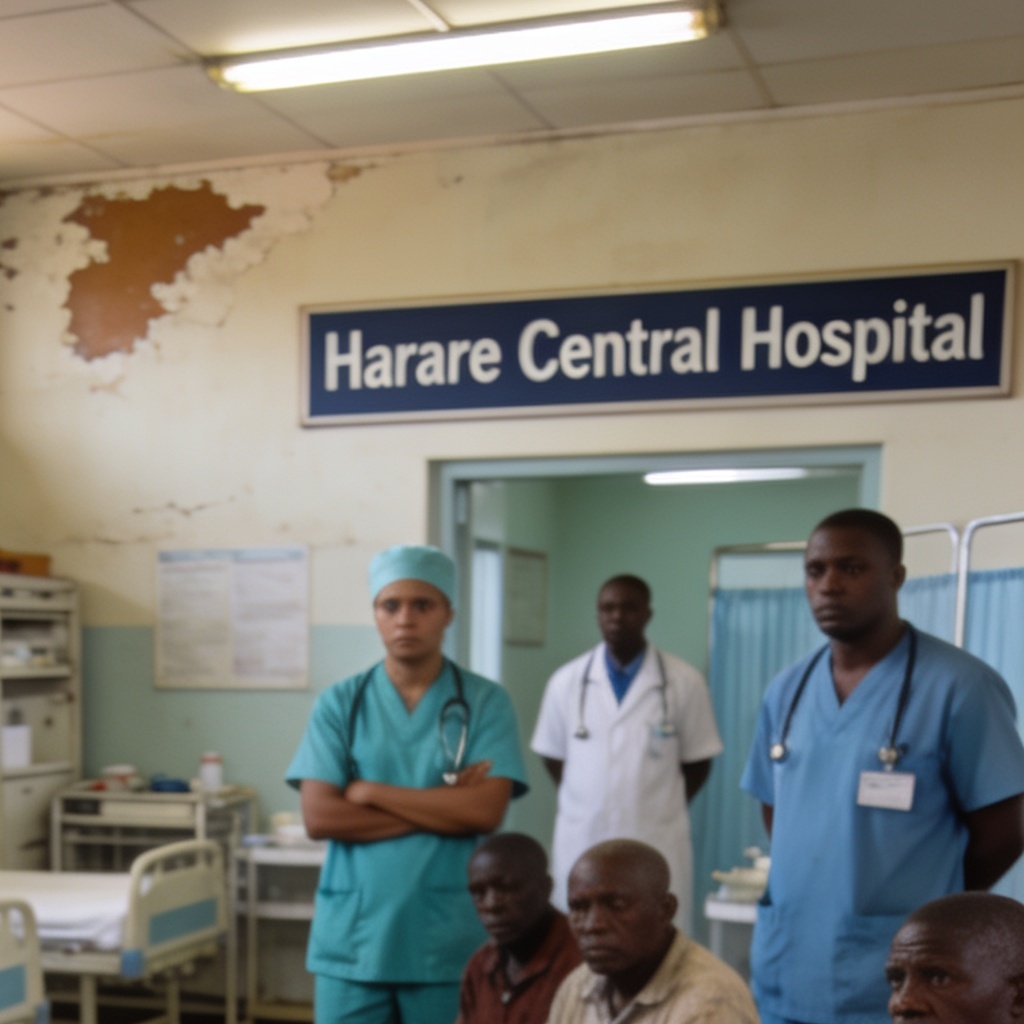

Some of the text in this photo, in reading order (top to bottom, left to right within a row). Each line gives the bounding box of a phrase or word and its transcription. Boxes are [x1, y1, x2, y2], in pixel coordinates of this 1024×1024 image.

[324, 293, 985, 392] Harare Central Hospital
